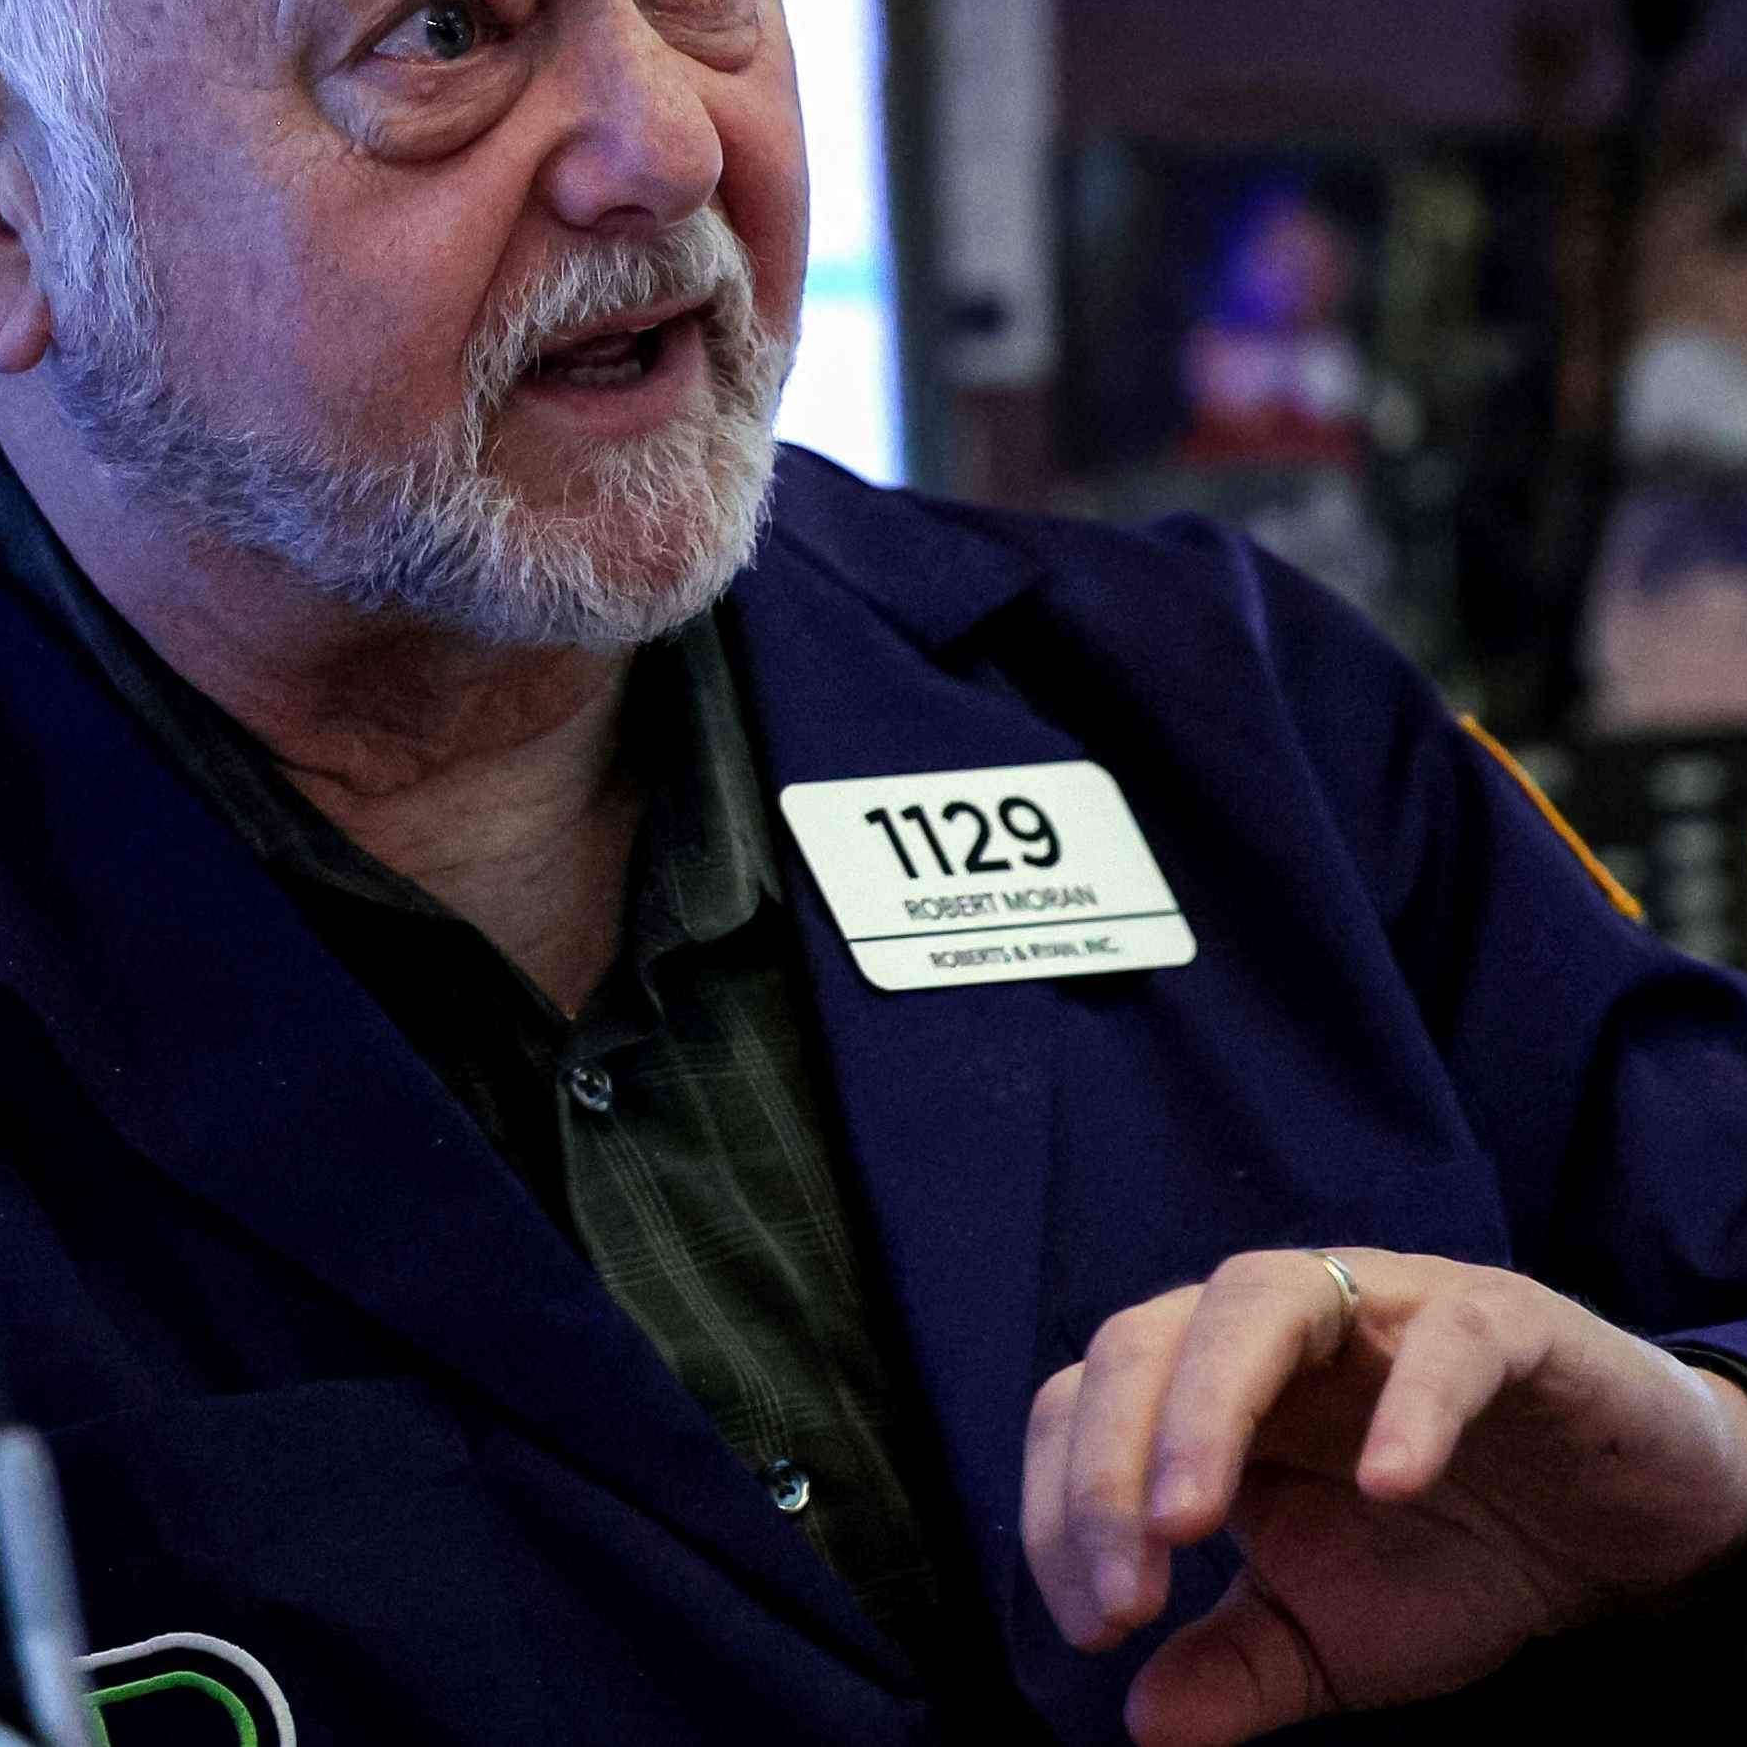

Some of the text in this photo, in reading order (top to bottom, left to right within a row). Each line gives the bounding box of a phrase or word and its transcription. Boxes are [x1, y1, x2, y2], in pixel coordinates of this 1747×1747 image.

[864, 796, 1061, 880] 1129
[904, 884, 1099, 920] ROBERT MORAN
[928, 945, 1012, 969] ROBERTS
[1013, 944, 1028, 962] &
